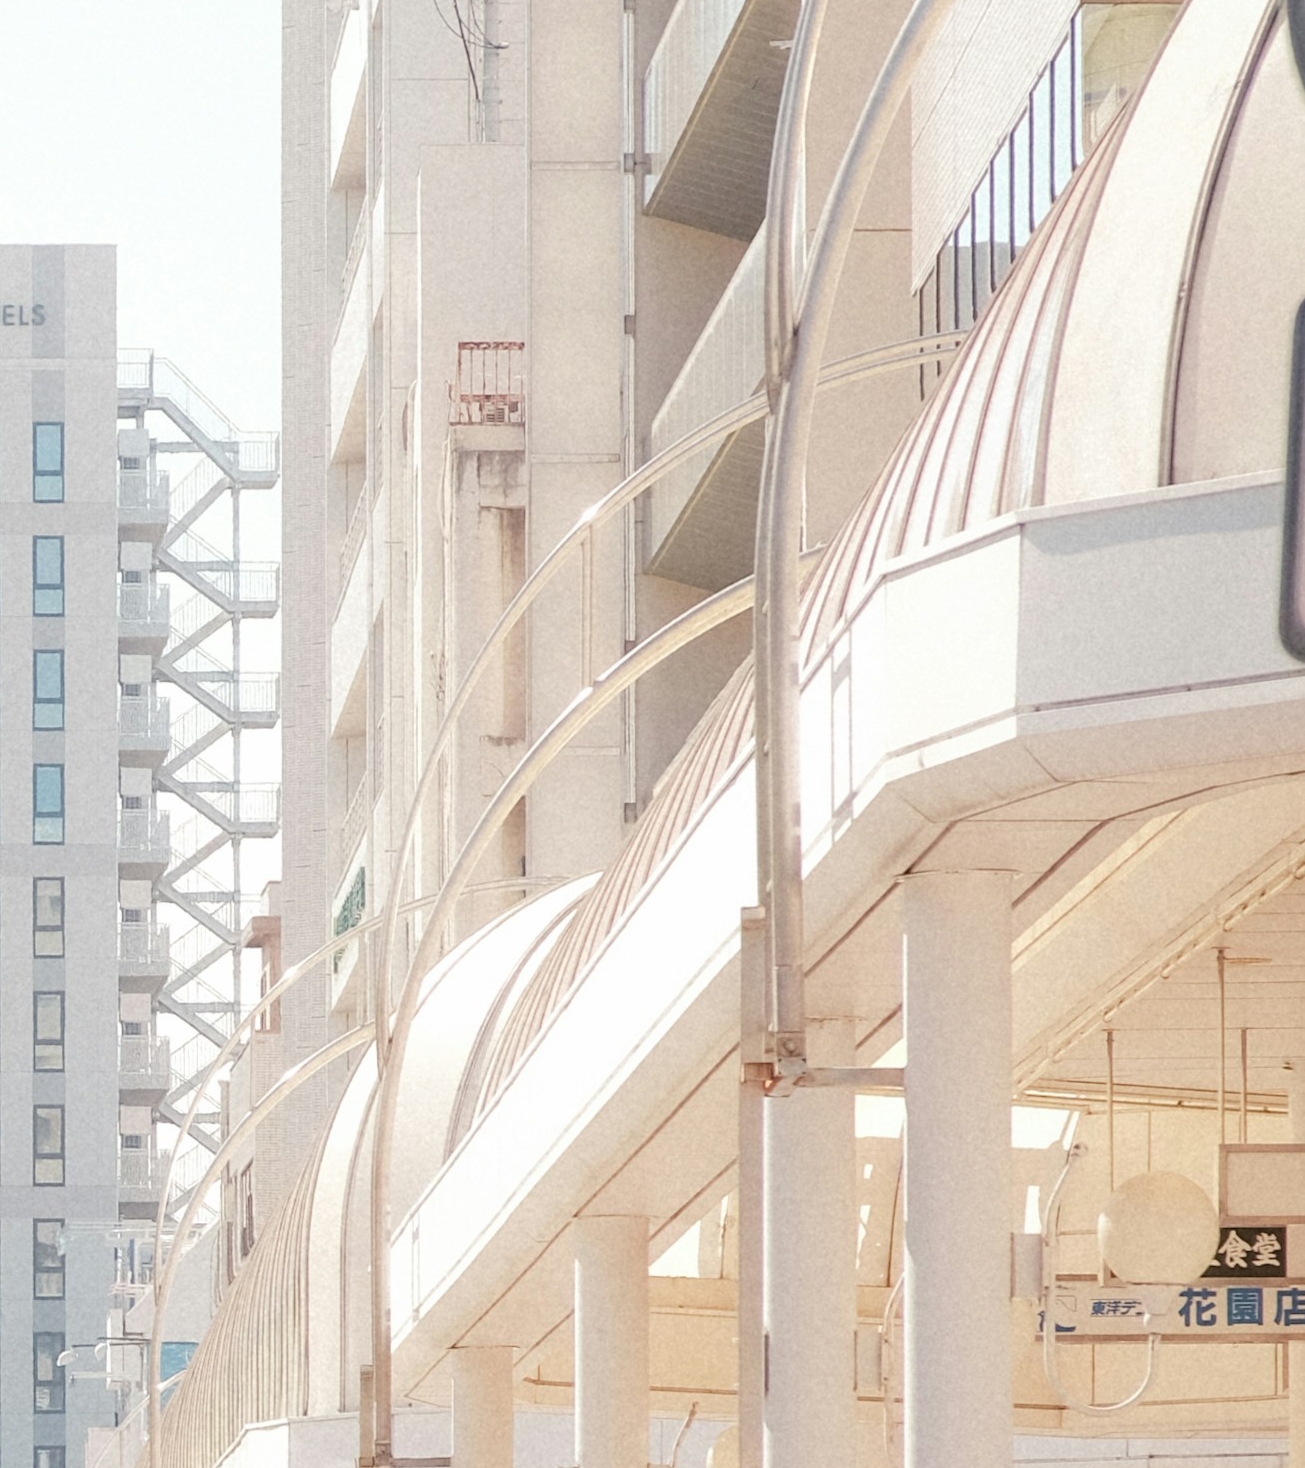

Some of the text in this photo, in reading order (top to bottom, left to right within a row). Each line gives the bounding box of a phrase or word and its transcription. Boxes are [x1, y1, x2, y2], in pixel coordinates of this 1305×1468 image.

[1210, 1229, 1282, 1269] 食堂
[1178, 1286, 1305, 1327] 花園店
